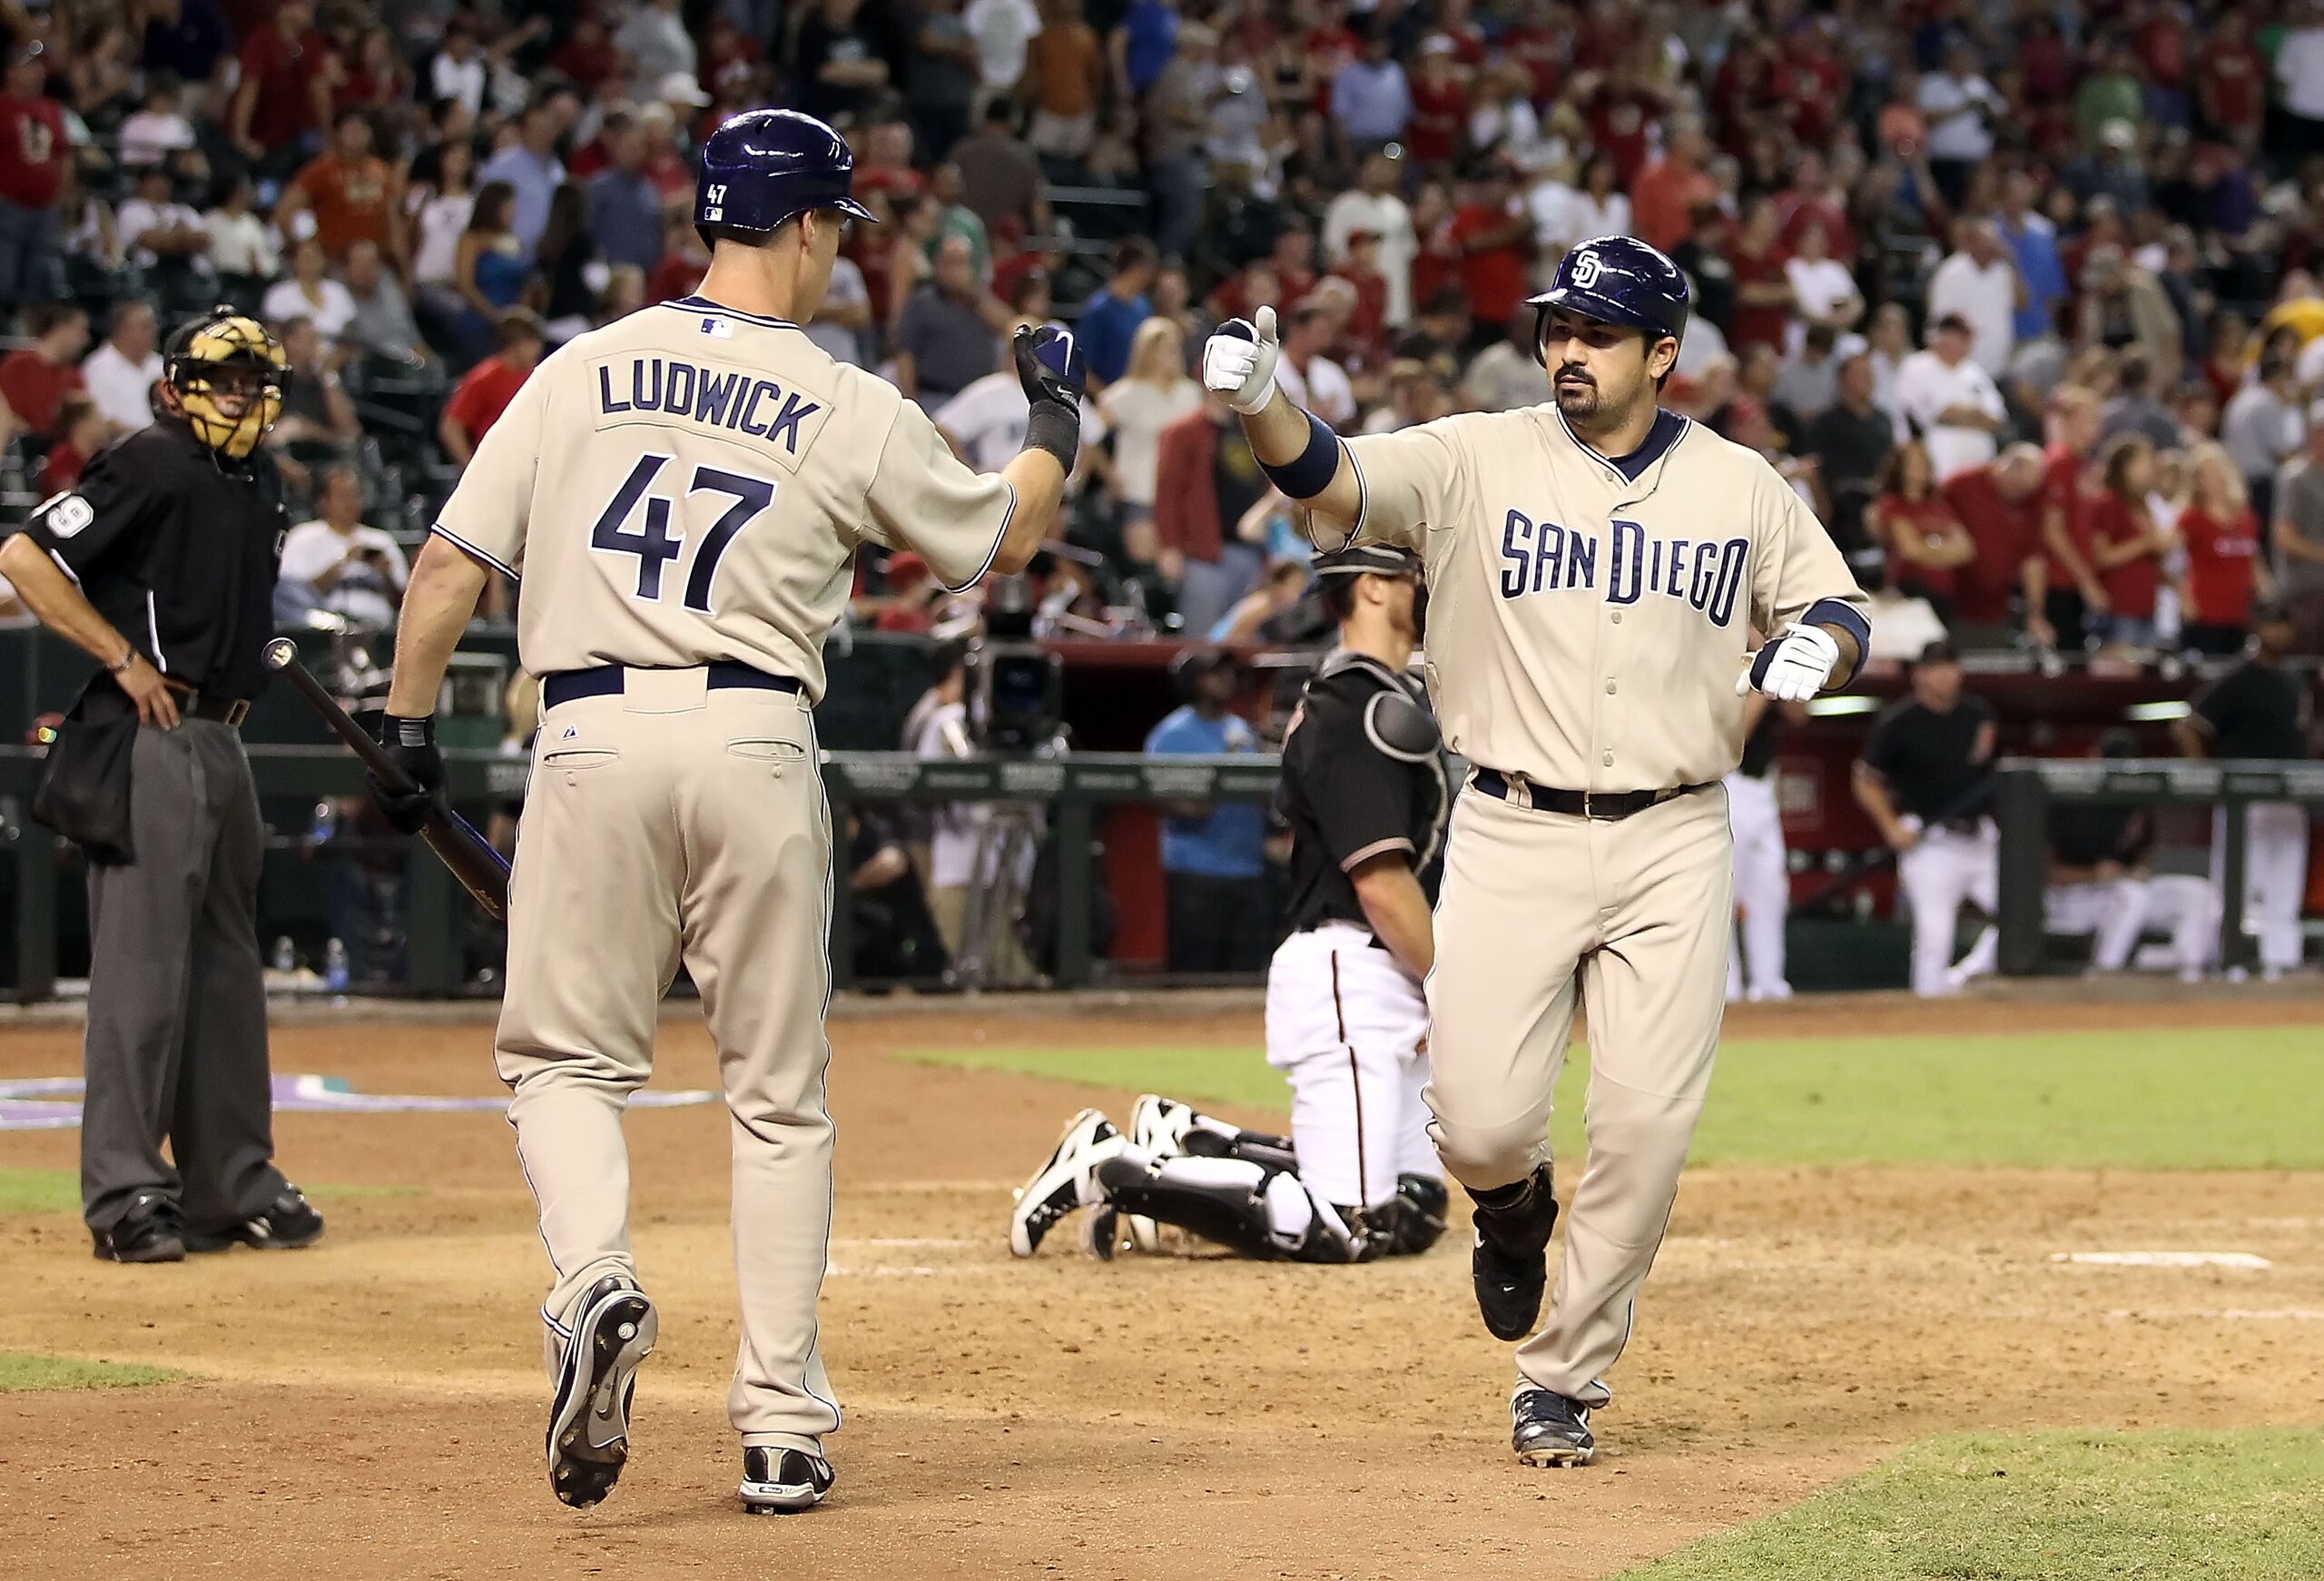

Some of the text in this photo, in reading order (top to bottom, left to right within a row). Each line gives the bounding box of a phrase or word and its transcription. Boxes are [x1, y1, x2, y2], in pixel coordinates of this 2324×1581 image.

[706, 183, 728, 204] 47
[1571, 250, 1601, 289] SD
[598, 358, 822, 455] LUDWICK
[588, 450, 780, 618] 47
[1500, 508, 1749, 627] SAN DIEGO
